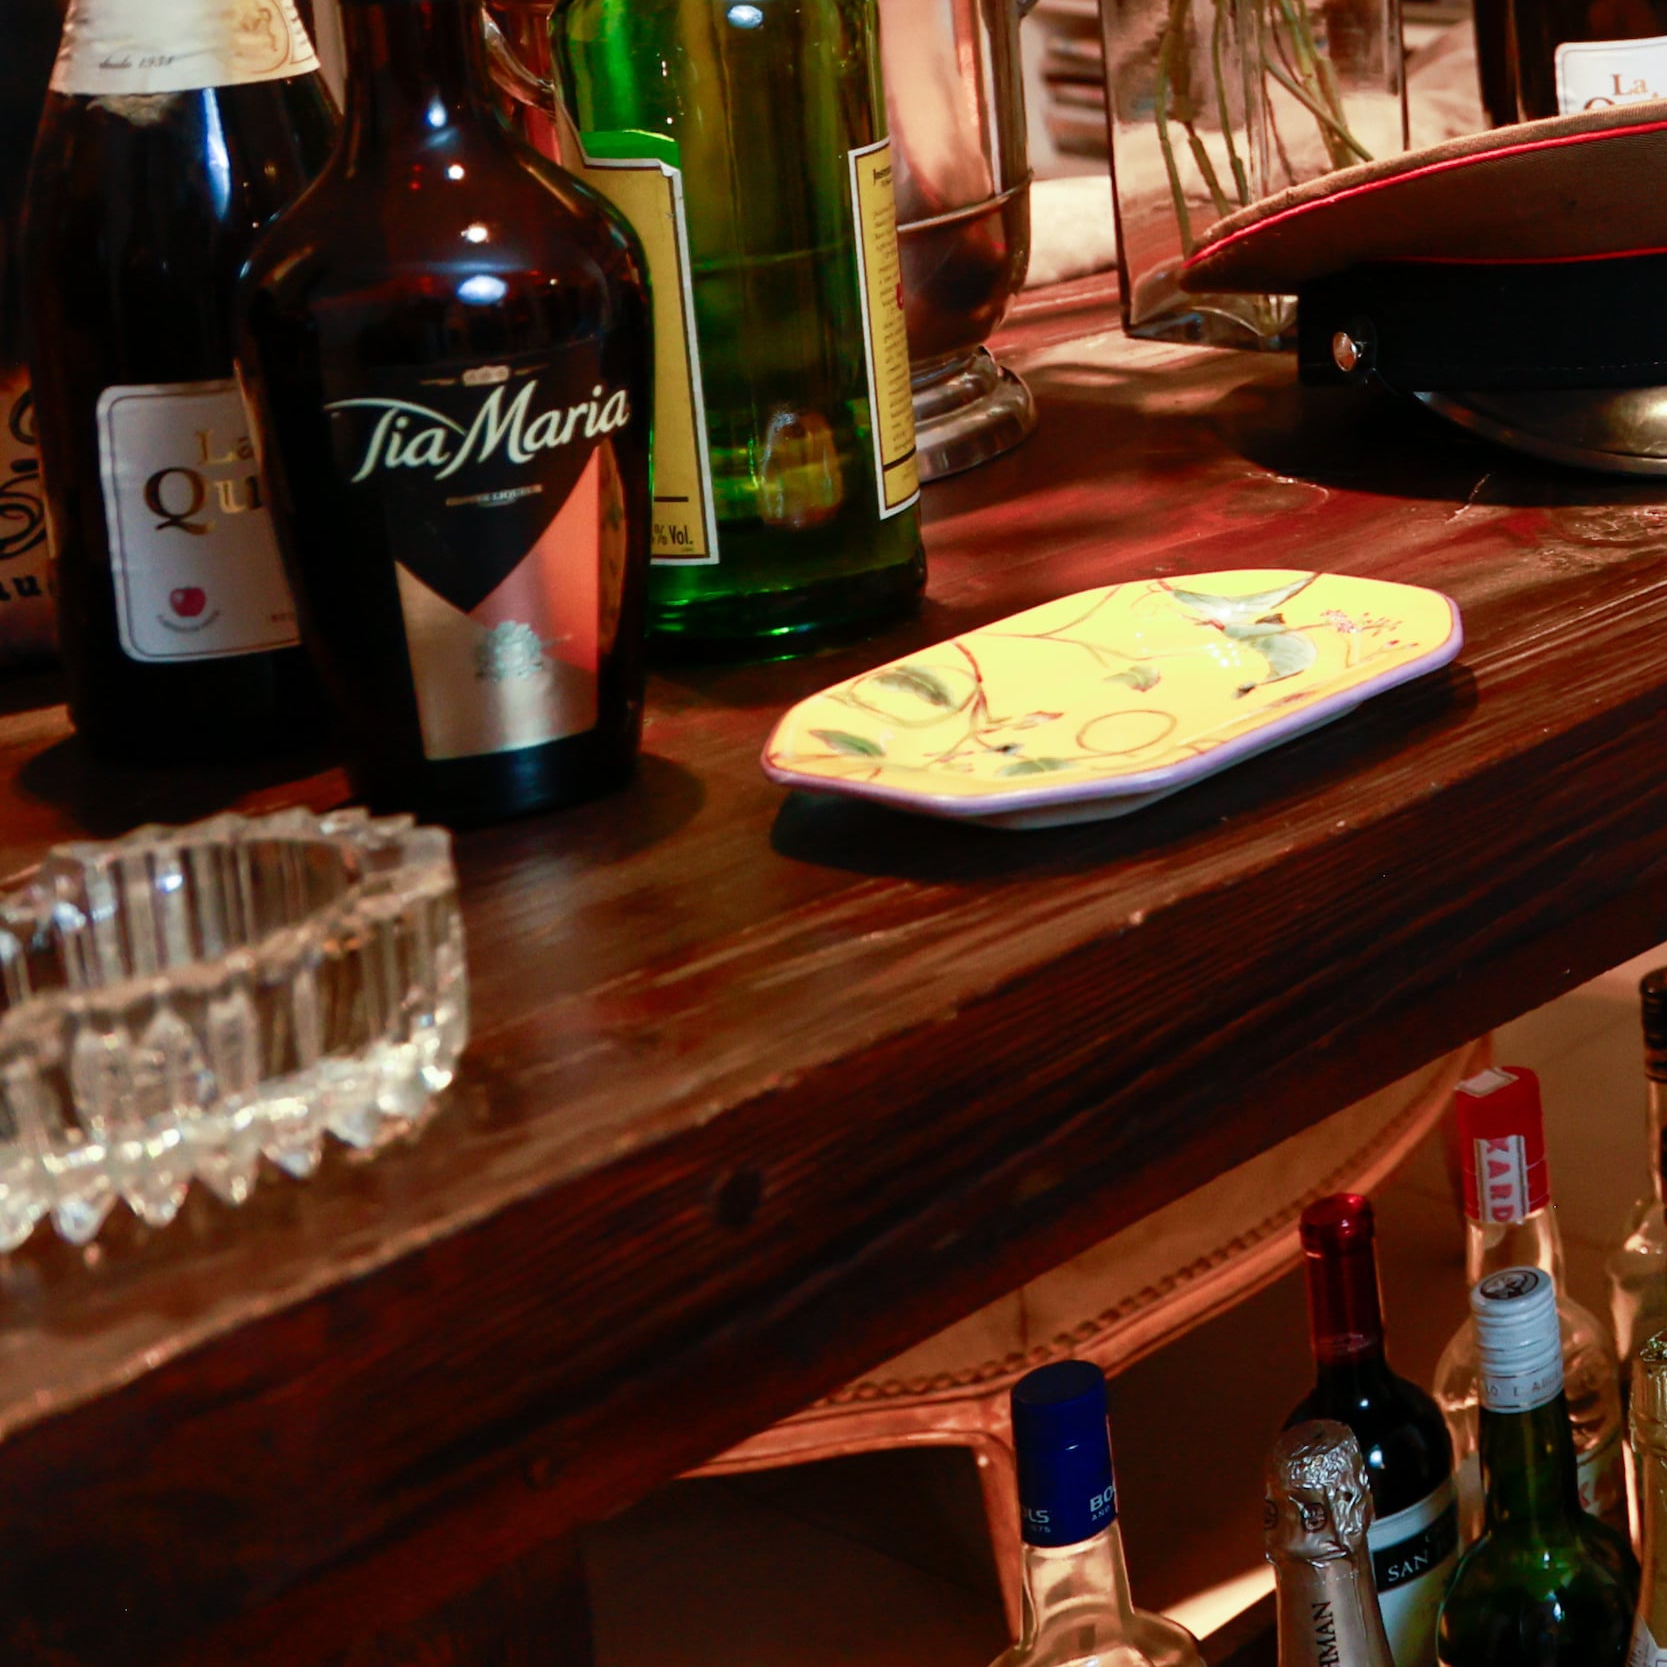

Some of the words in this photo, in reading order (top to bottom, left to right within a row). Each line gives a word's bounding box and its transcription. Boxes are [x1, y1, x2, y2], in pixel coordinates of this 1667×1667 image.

[1611, 72, 1648, 96] La
[324, 397, 466, 483] Tia
[435, 379, 631, 481] Maria
[669, 525, 694, 547] Vol.
[1089, 1485, 1114, 1513] BO
[1387, 1549, 1429, 1583] SAN
